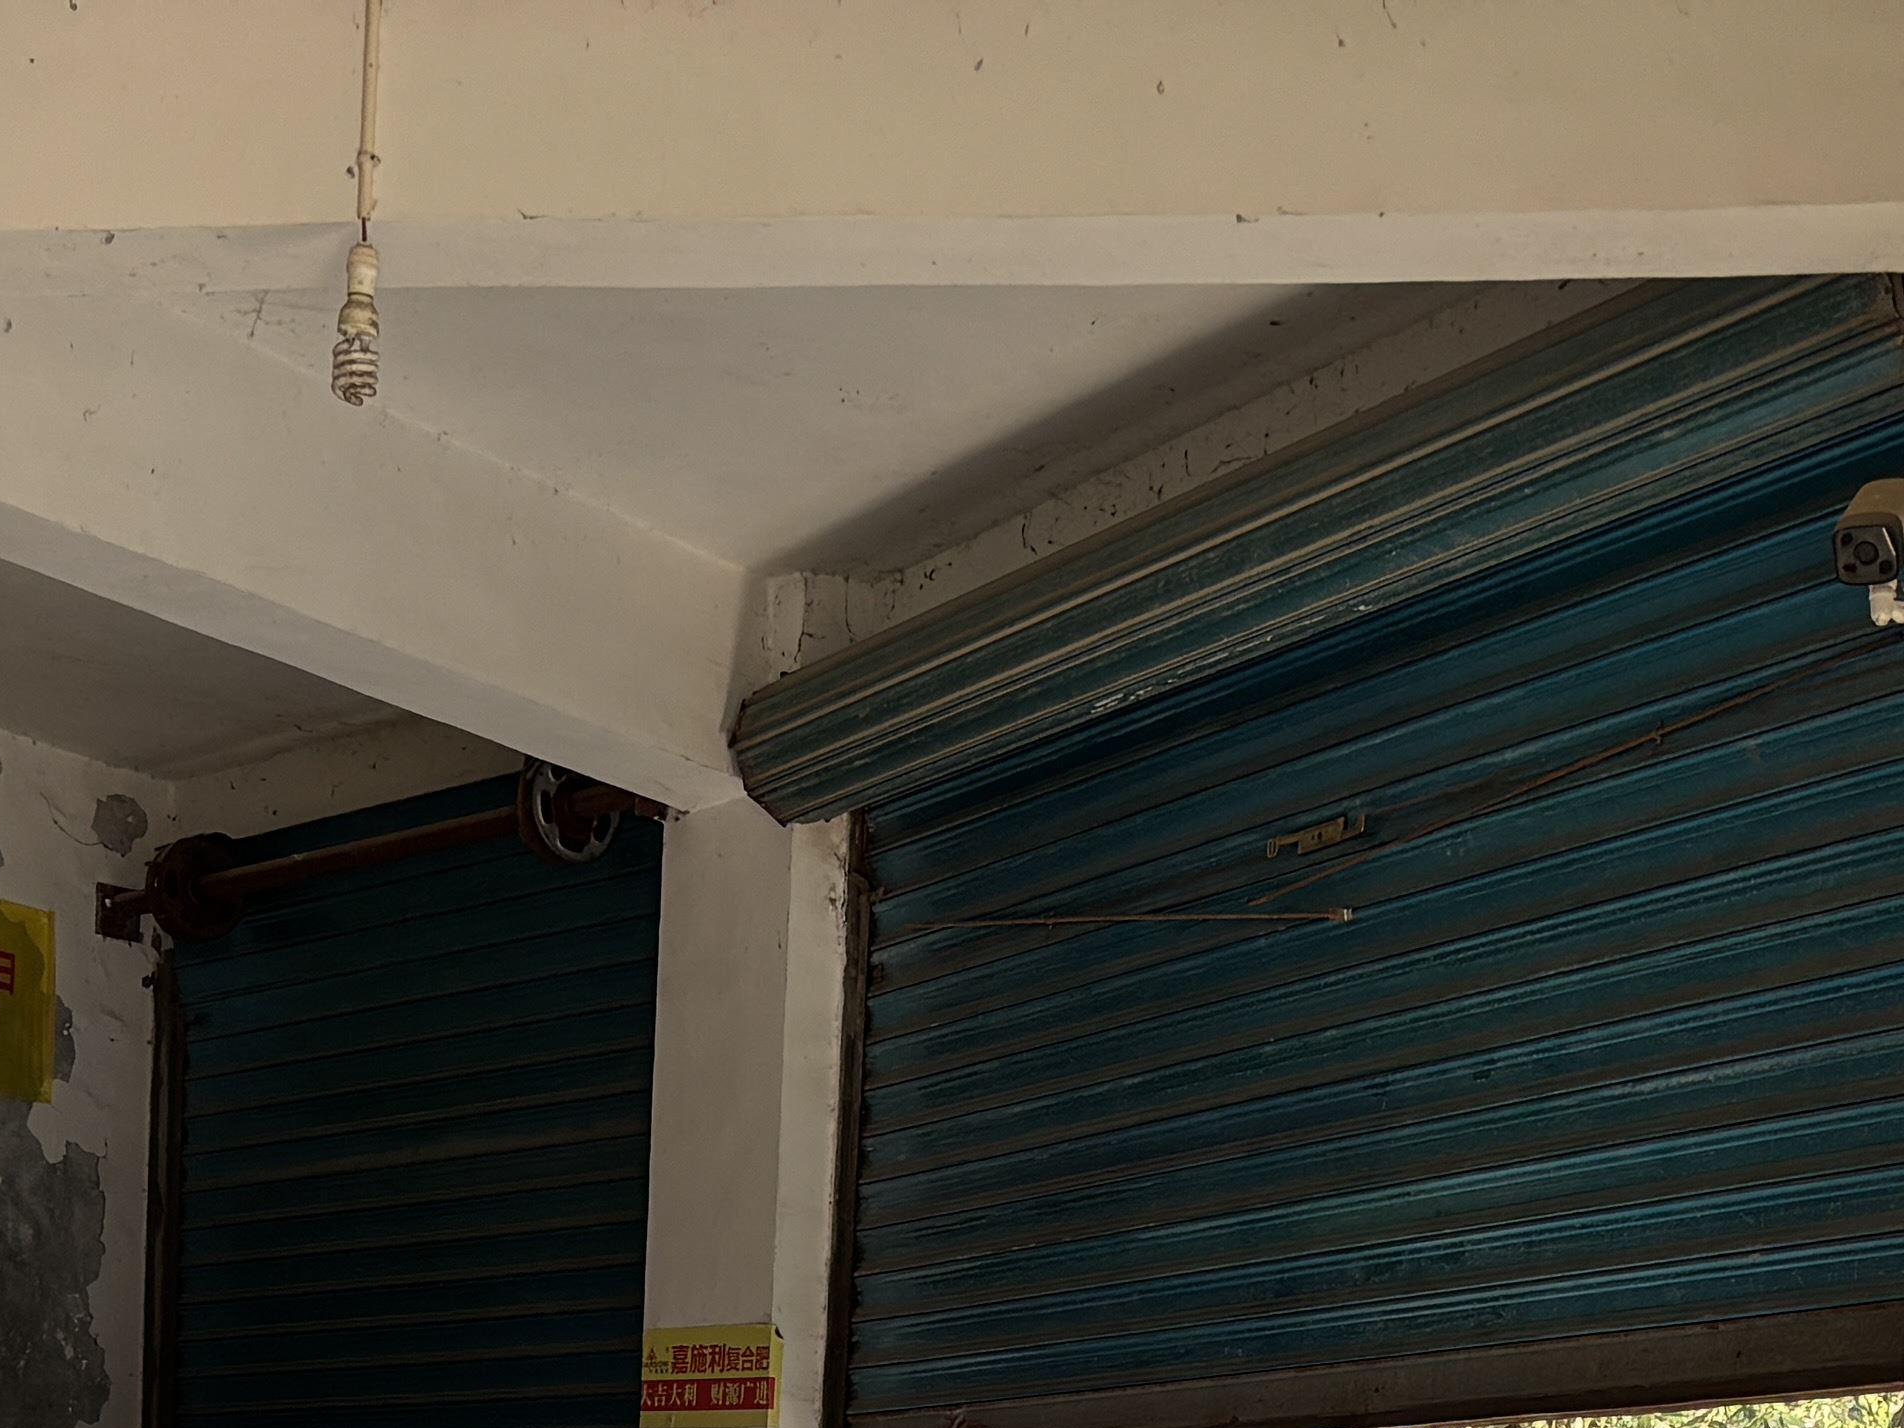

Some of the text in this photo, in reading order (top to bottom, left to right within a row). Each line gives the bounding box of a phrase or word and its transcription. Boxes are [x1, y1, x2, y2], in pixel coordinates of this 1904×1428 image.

[670, 1344, 771, 1374] 嘉施利复合肥
[711, 1380, 768, 1406] 财源广进
